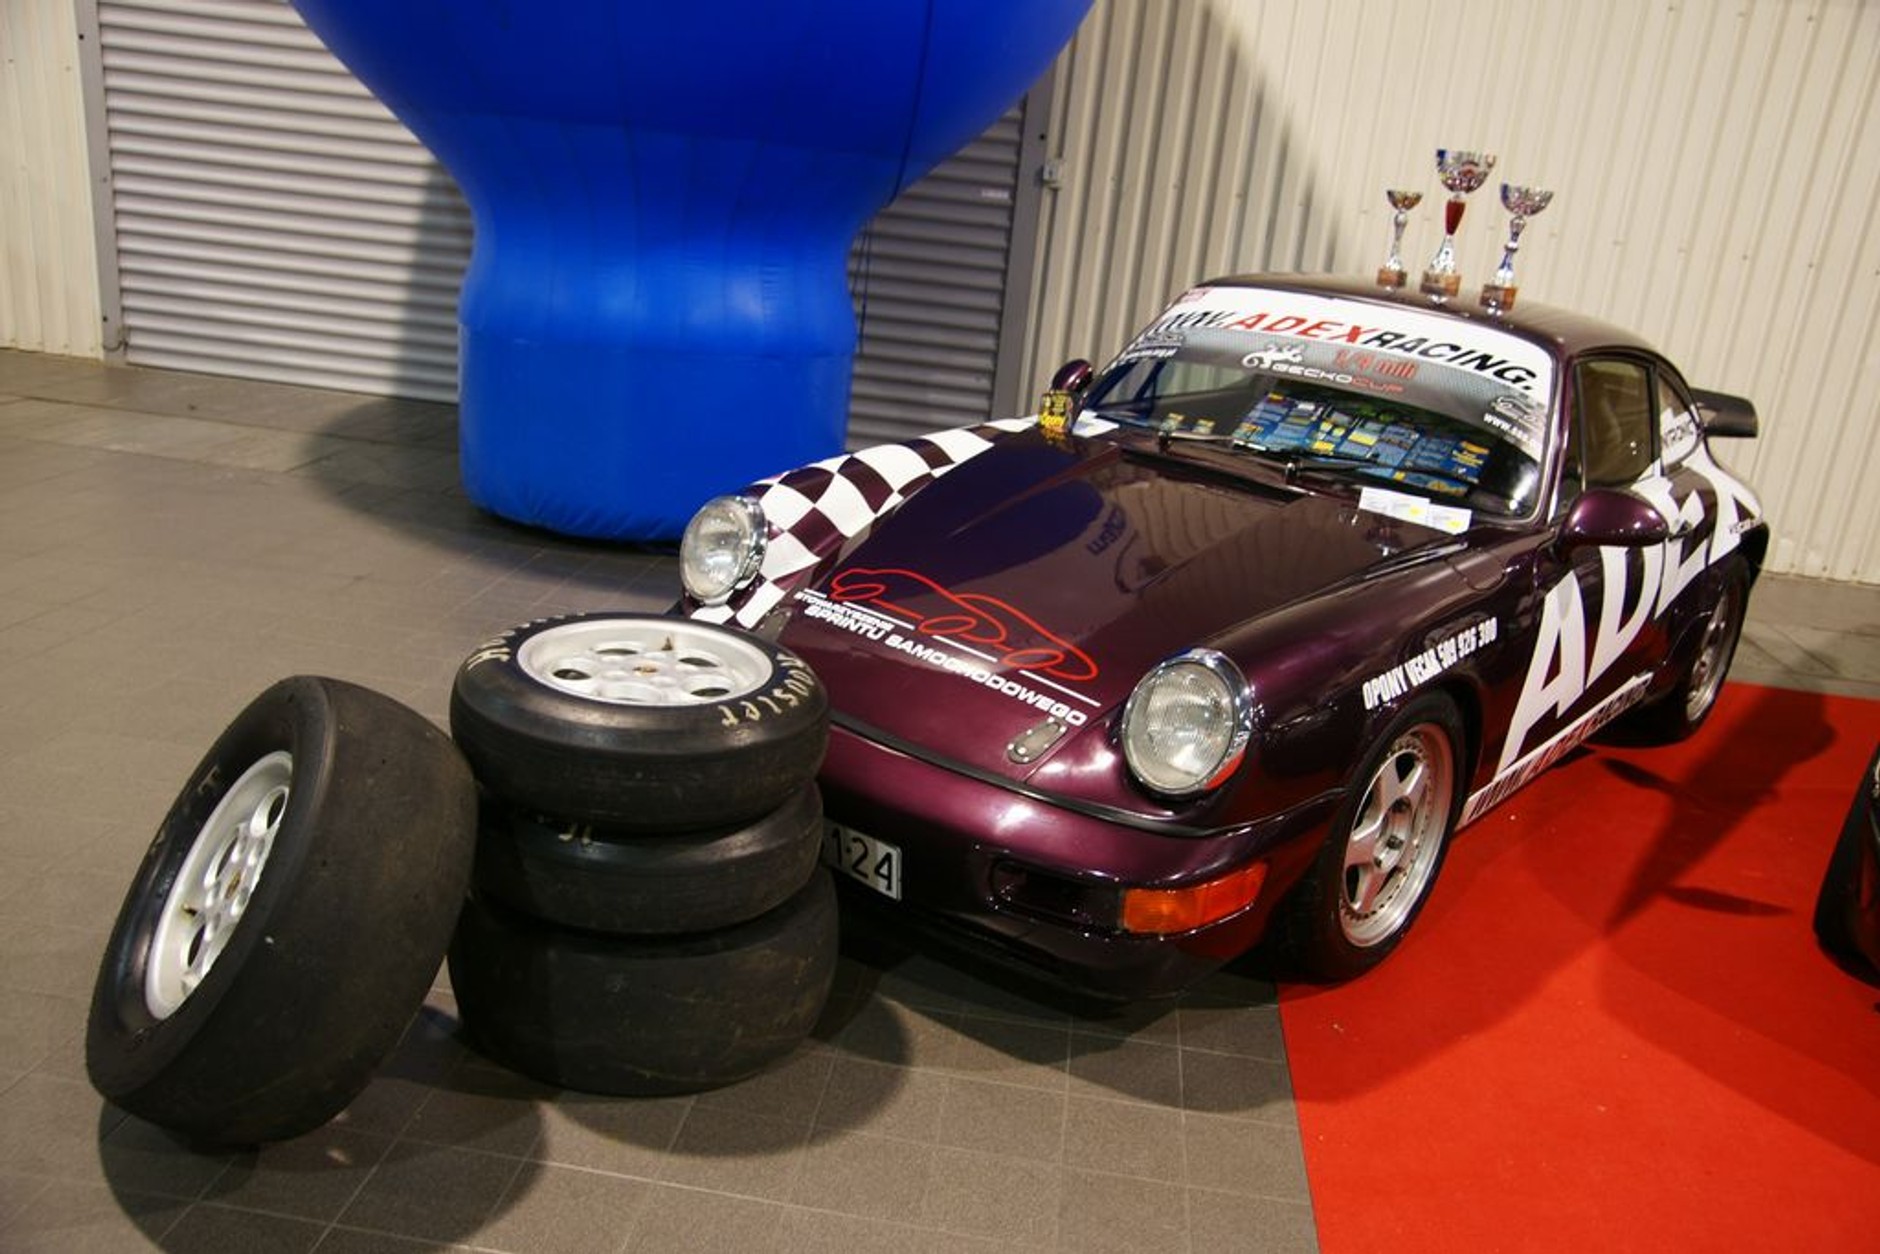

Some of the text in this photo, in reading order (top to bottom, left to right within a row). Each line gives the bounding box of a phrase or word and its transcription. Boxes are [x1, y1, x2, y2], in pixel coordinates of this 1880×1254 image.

[804, 604, 885, 640] SPRINTU
[1362, 664, 1408, 711] OPONY
[820, 827, 893, 891] 124
